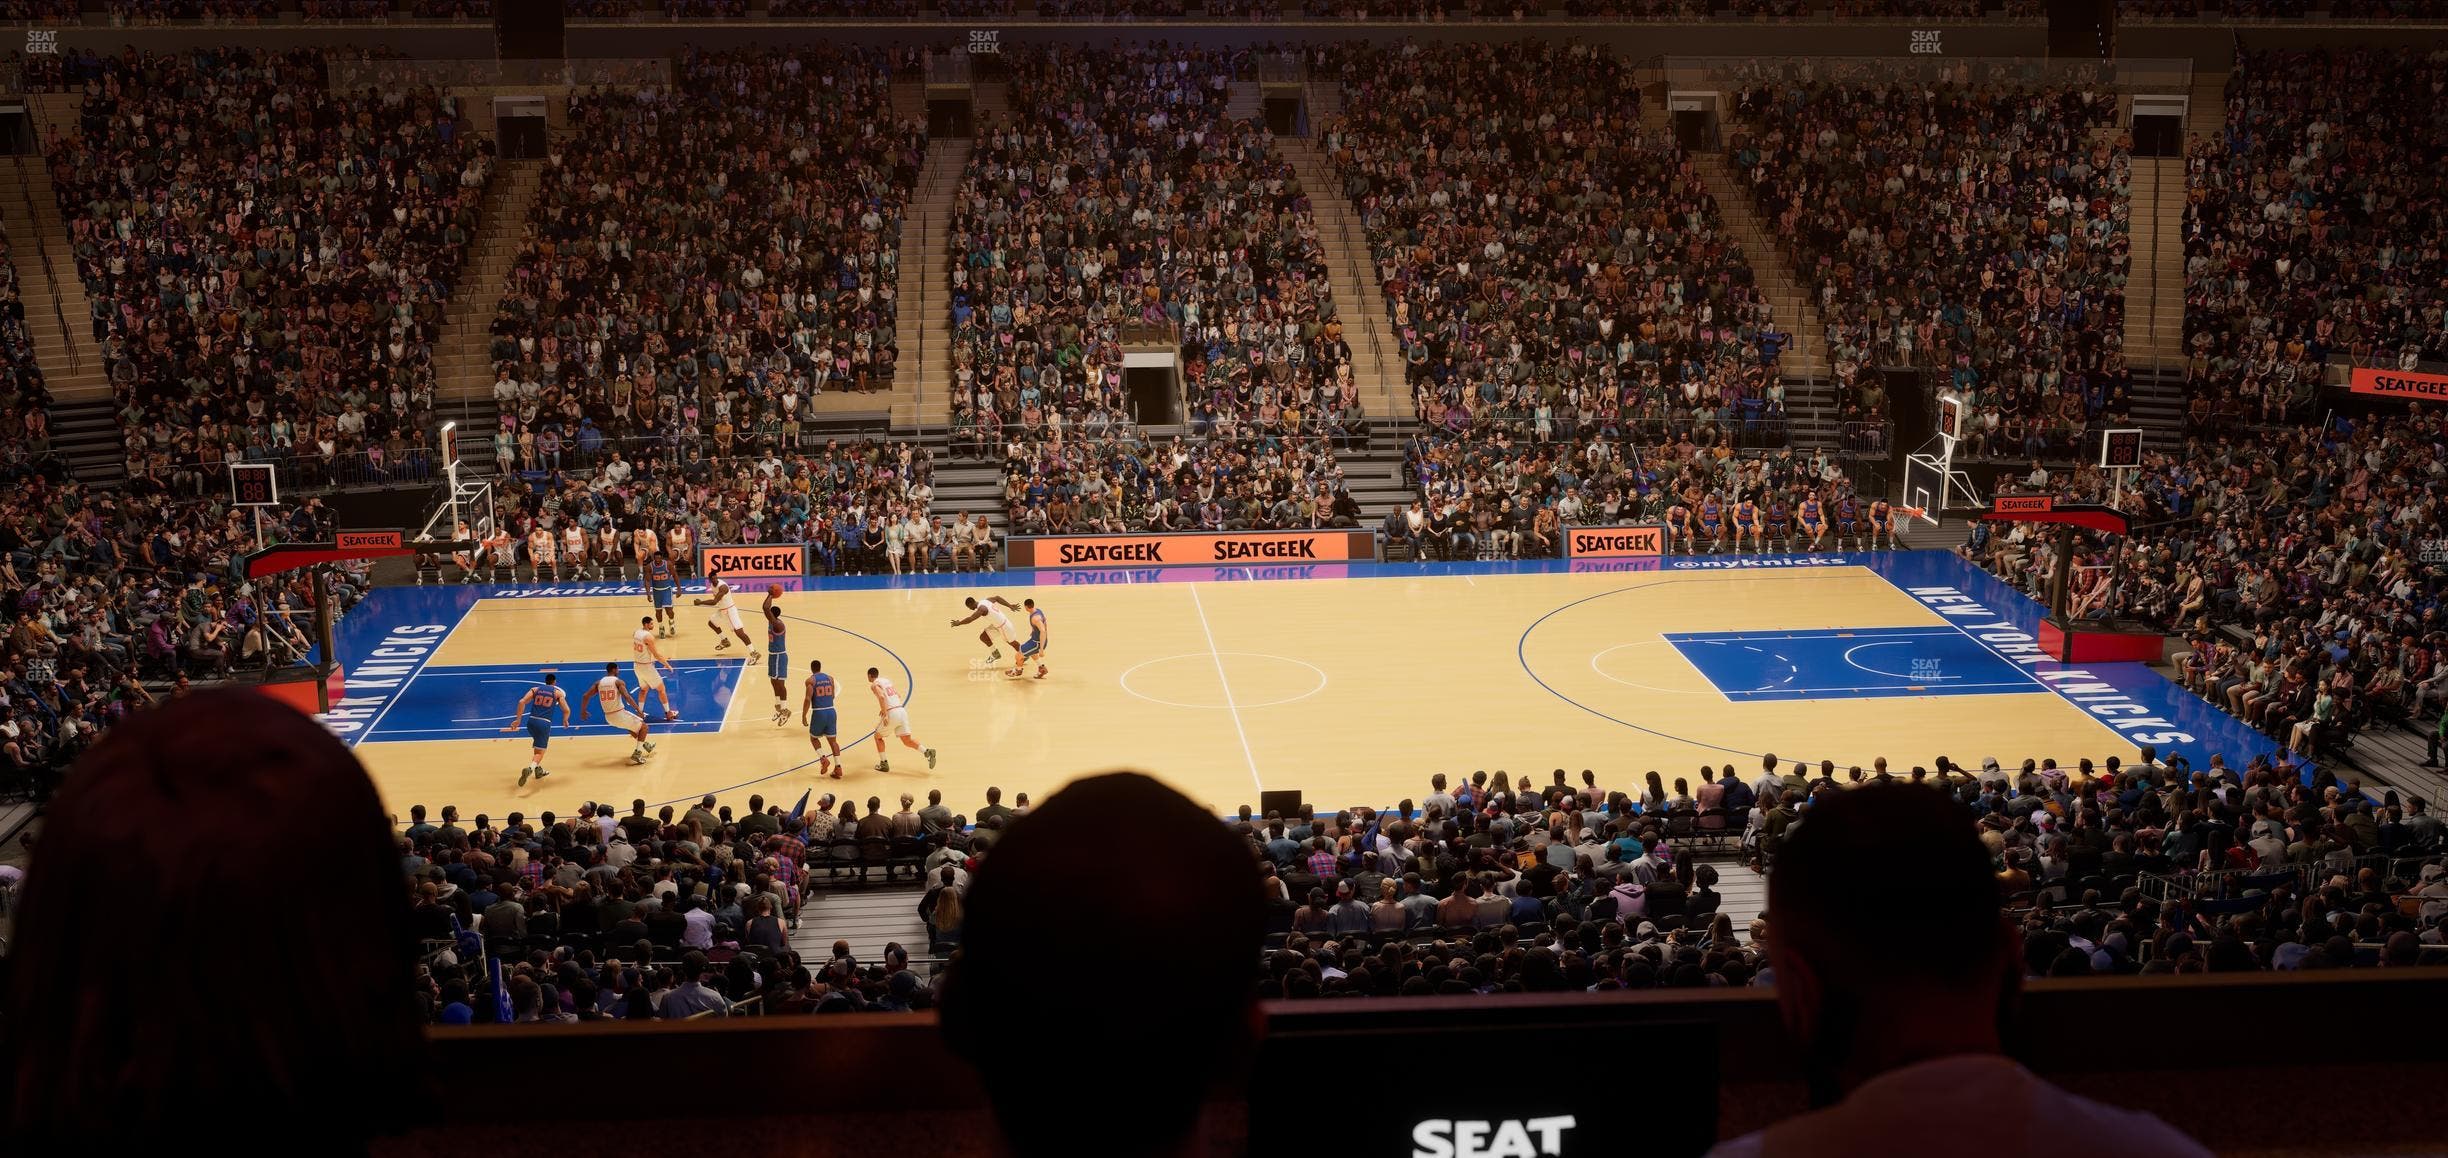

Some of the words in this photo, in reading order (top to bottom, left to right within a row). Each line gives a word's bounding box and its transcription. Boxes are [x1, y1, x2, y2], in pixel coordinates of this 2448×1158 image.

[2374, 376, 2448, 395] SEATGEE
[2001, 500, 2045, 510] SEATGEEK
[343, 535, 395, 546] SEATGEEK
[1214, 538, 1316, 560] SEATGEEK
[1576, 533, 1657, 553] SEATGEEK
[711, 552, 797, 572] SEATGEEK
[1060, 541, 1164, 564] SEATGEEK
[1673, 557, 1846, 569] @nyknicks
[344, 624, 447, 689] KNICKS
[1906, 587, 1995, 616] NEW
[1963, 621, 2060, 665] YORK
[2034, 670, 2196, 744] KNICKS
[600, 689, 615, 702] 00
[816, 685, 832, 697] 00
[534, 695, 554, 708] 00
[314, 695, 388, 742] ORK
[1411, 1114, 1577, 1158] SEAT
